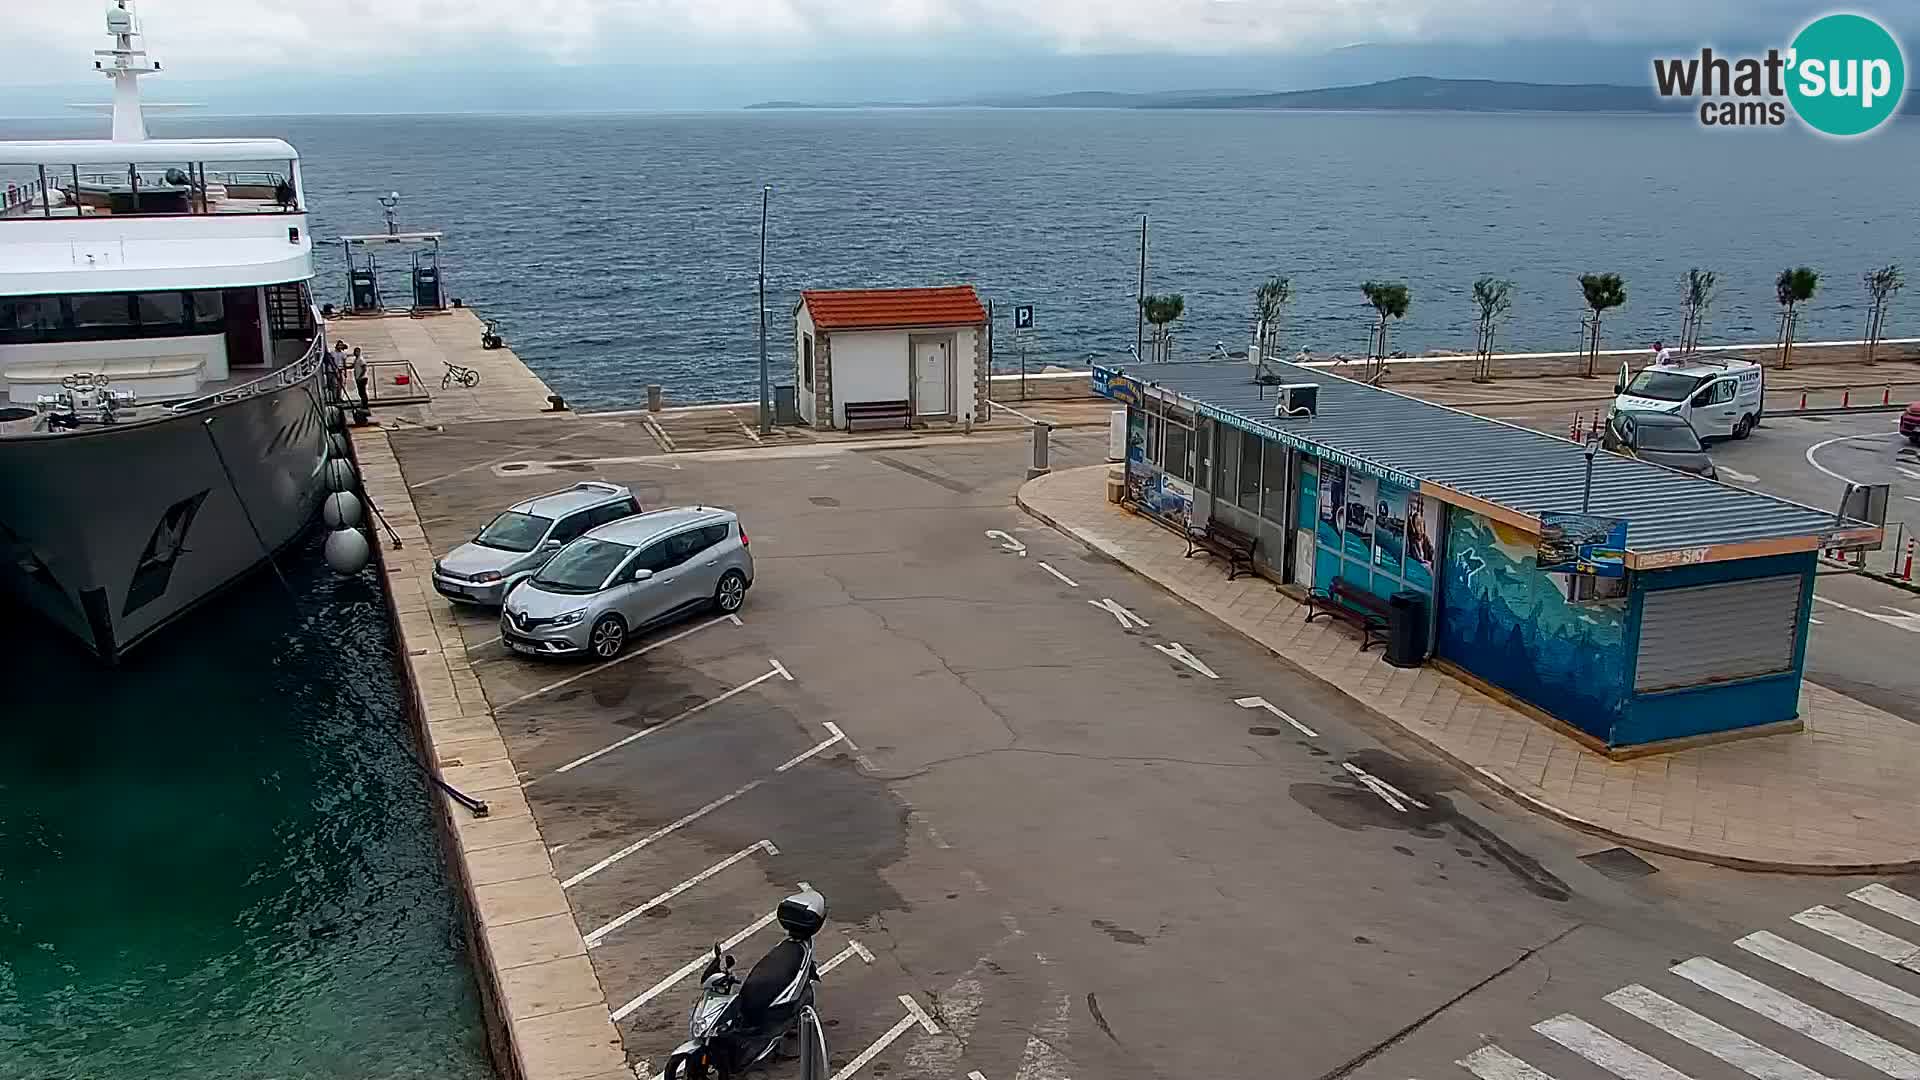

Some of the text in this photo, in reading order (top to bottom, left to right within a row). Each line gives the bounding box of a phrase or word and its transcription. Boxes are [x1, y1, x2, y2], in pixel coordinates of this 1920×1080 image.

[1019, 308, 1029, 325] P
[1278, 432, 1306, 450] POSTAJA
[1316, 445, 1330, 459] BUS
[1331, 451, 1362, 470] STATION
[1364, 462, 1388, 479] TICKET
[1389, 471, 1416, 489] OFFICE
